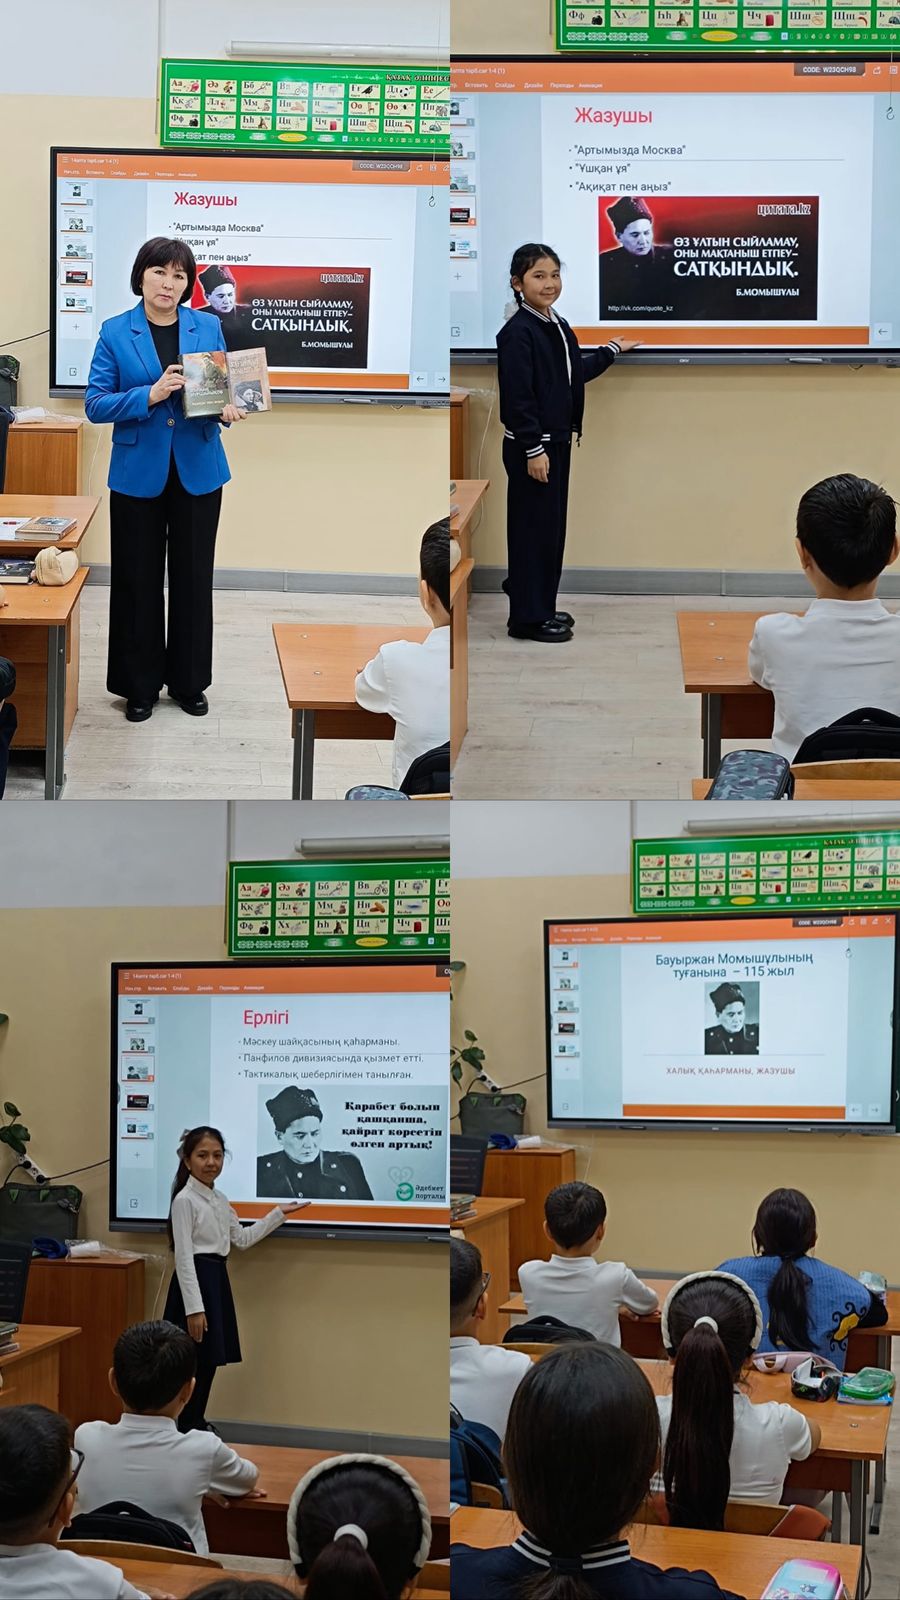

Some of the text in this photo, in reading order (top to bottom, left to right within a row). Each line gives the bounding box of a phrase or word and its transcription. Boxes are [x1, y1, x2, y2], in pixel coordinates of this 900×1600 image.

[171, 79, 183, 87] Аа
[575, 106, 653, 127] Жазушы
[574, 144, 686, 156] "Артымызда Москва"
[575, 181, 671, 193] "Ақиқат пен аңыз"
[174, 191, 238, 209] Жазушы
[757, 203, 811, 216] цитата.kz
[173, 222, 264, 232] "Артымызда Москва"
[673, 235, 799, 248] ӨЗ ҰЛТЫН СЫЙЛАМАУ,
[226, 253, 252, 262] аңыз"
[673, 249, 699, 258] ОНЫ
[701, 249, 759, 259] МАҚТАНЫШ
[673, 260, 799, 278] САТҚЫНДЫҚ.
[252, 298, 354, 309] ӨЗ ҰЛТЫН СЫЙЛАМАУ,
[607, 304, 674, 313] http://vk.com/quote_kz
[251, 308, 272, 316] ОНЫ
[274, 308, 321, 317] МАҚТАНЫШ
[251, 317, 353, 333] САТҚЫНДЫҚ.
[317, 881, 330, 890] Бб
[357, 881, 370, 889] Вв
[655, 952, 814, 968] Бауыржан Момышұлының
[673, 967, 727, 980] туғанына
[744, 966, 765, 977] 115
[767, 966, 795, 976] жыл
[243, 1009, 289, 1027] Ерлігі
[243, 1037, 400, 1048] Мәскеу шайқасының қаһарманы.
[243, 1053, 424, 1064] Панфилов дивизиясында қызмет етті.
[243, 1069, 414, 1080] Тактикалық шеберлігімен танылған.
[666, 1067, 696, 1076] ХАЛЫҚ
[756, 1066, 796, 1075] ЖАЗУШЫ
[344, 1101, 440, 1112] Қарабет болып
[342, 1126, 385, 1137] қайрат
